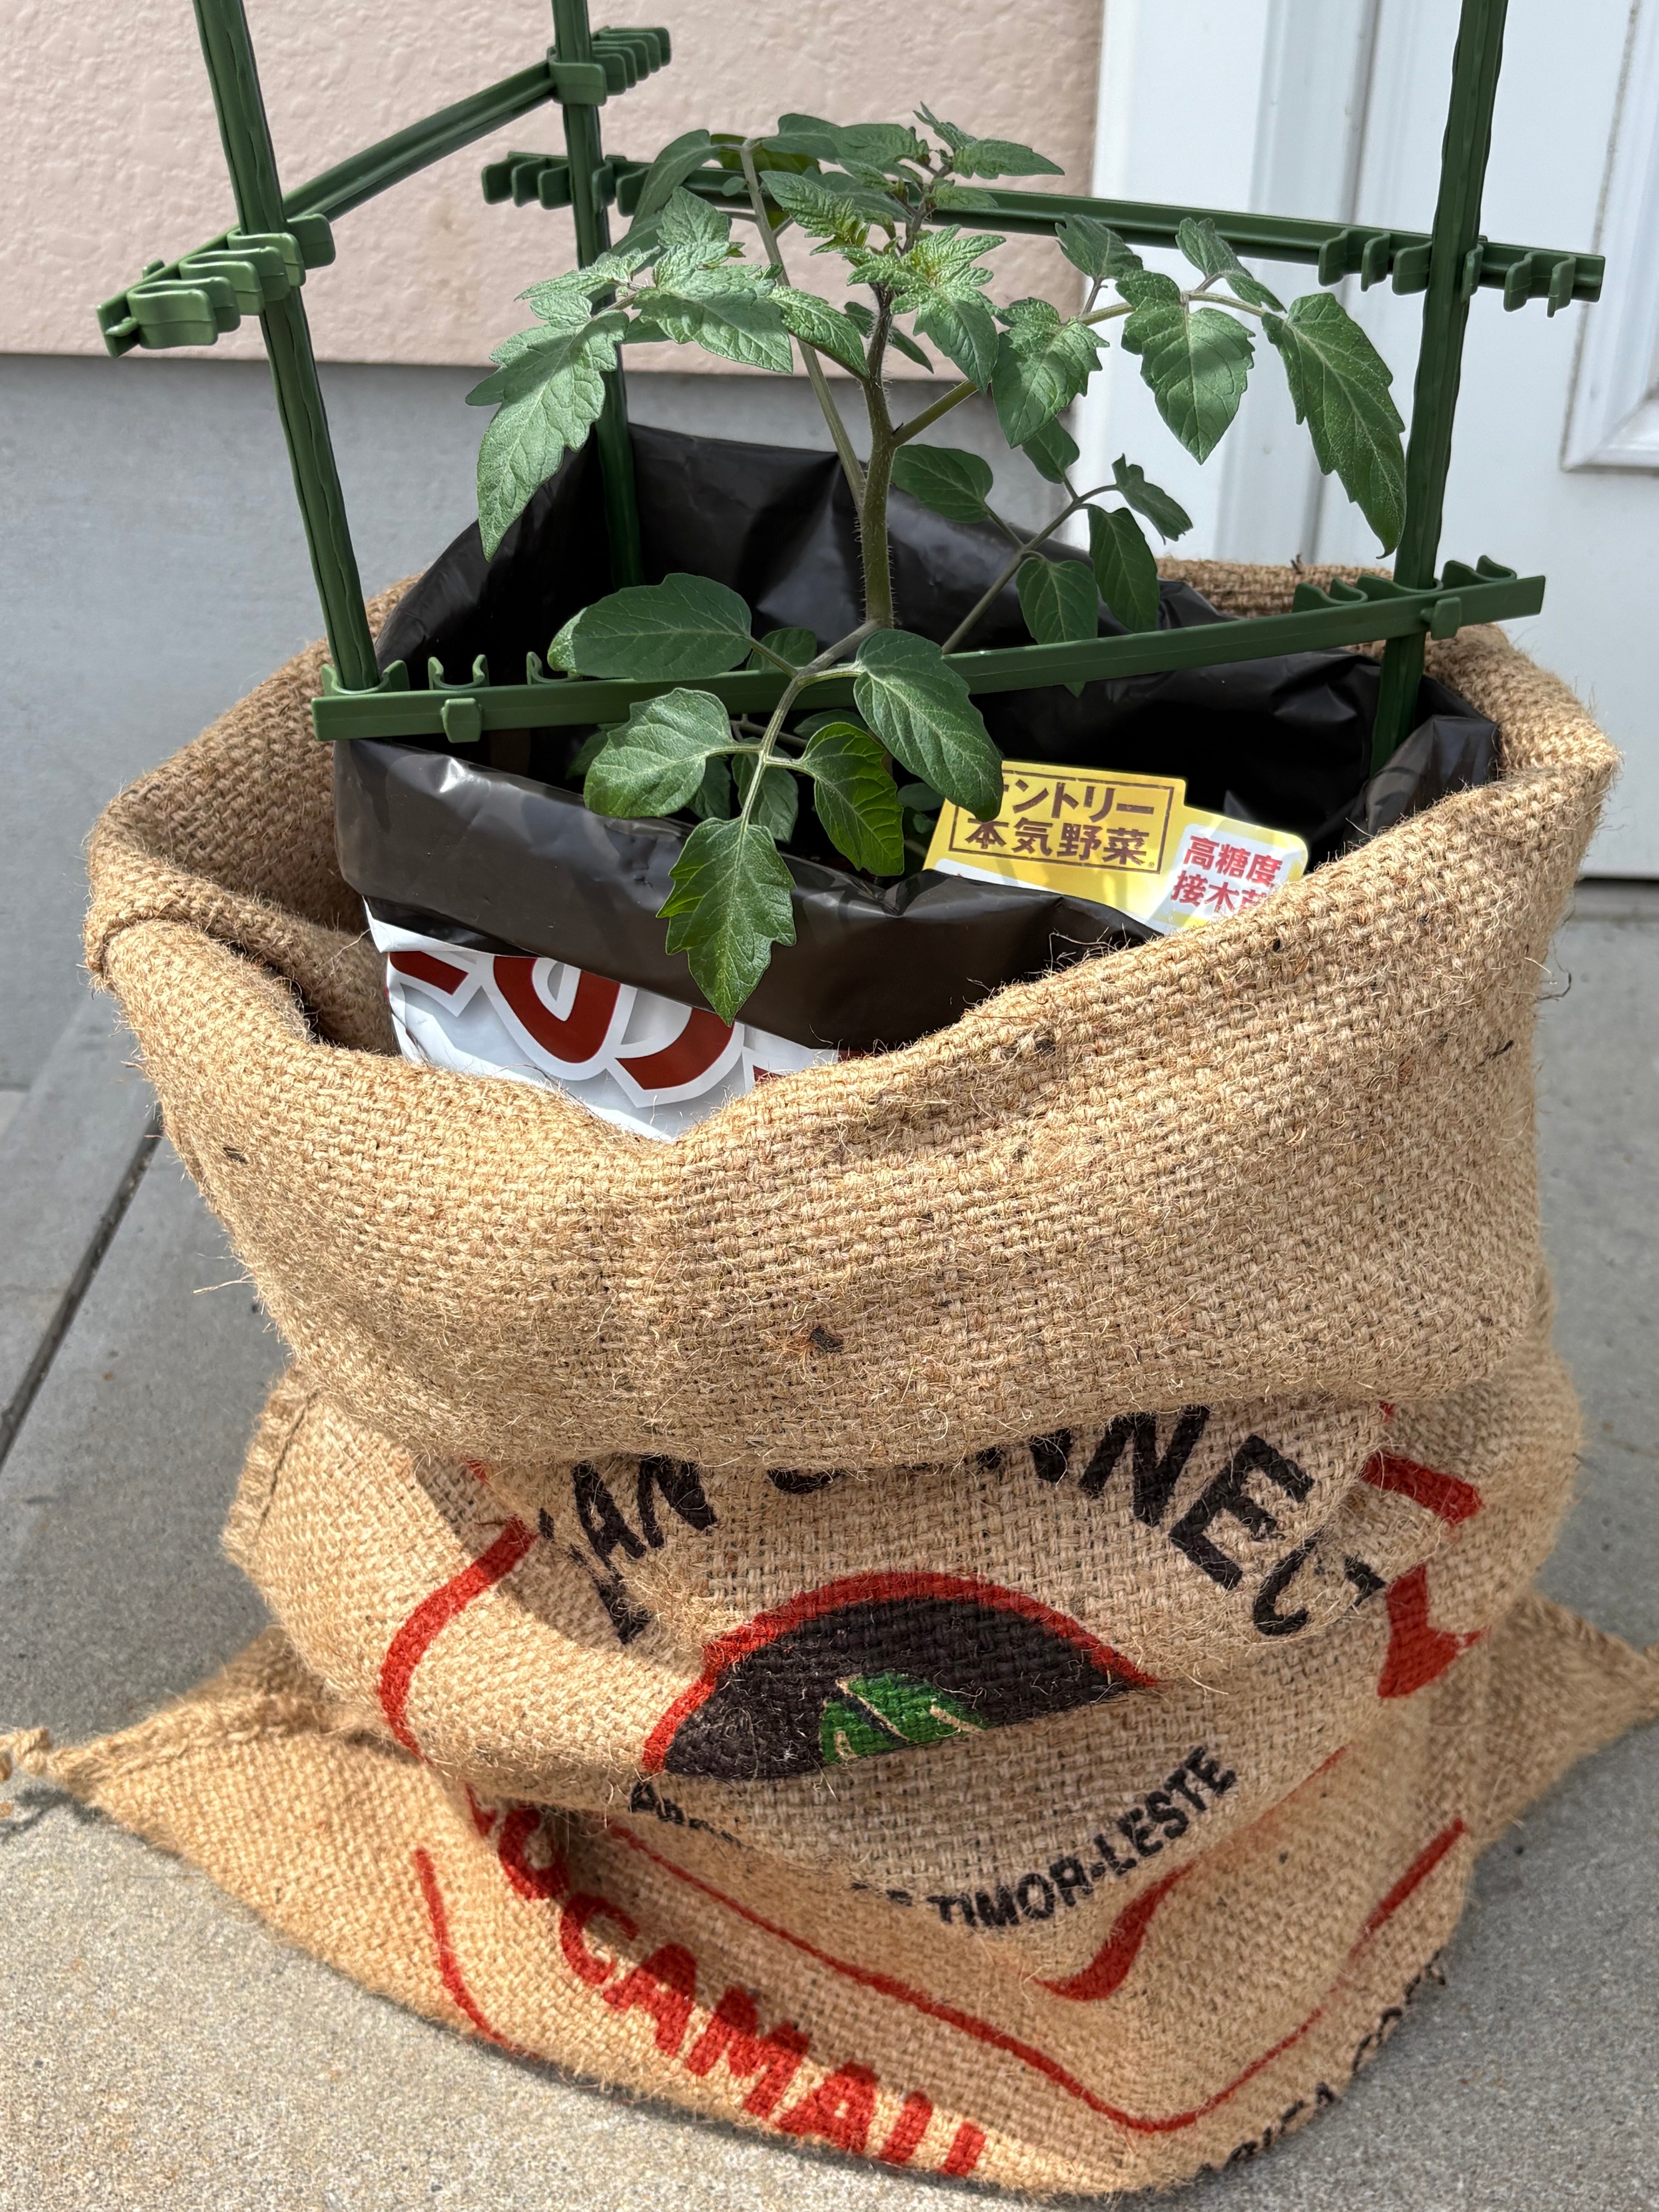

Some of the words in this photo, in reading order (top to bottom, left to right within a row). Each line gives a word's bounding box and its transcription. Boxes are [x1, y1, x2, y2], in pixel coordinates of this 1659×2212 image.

[1002, 778, 1154, 823] ントリー
[965, 816, 1150, 866] 本気野菜
[1183, 835, 1283, 888] 高糖度
[927, 1745, 1237, 1928] TIMOR-LESTE
